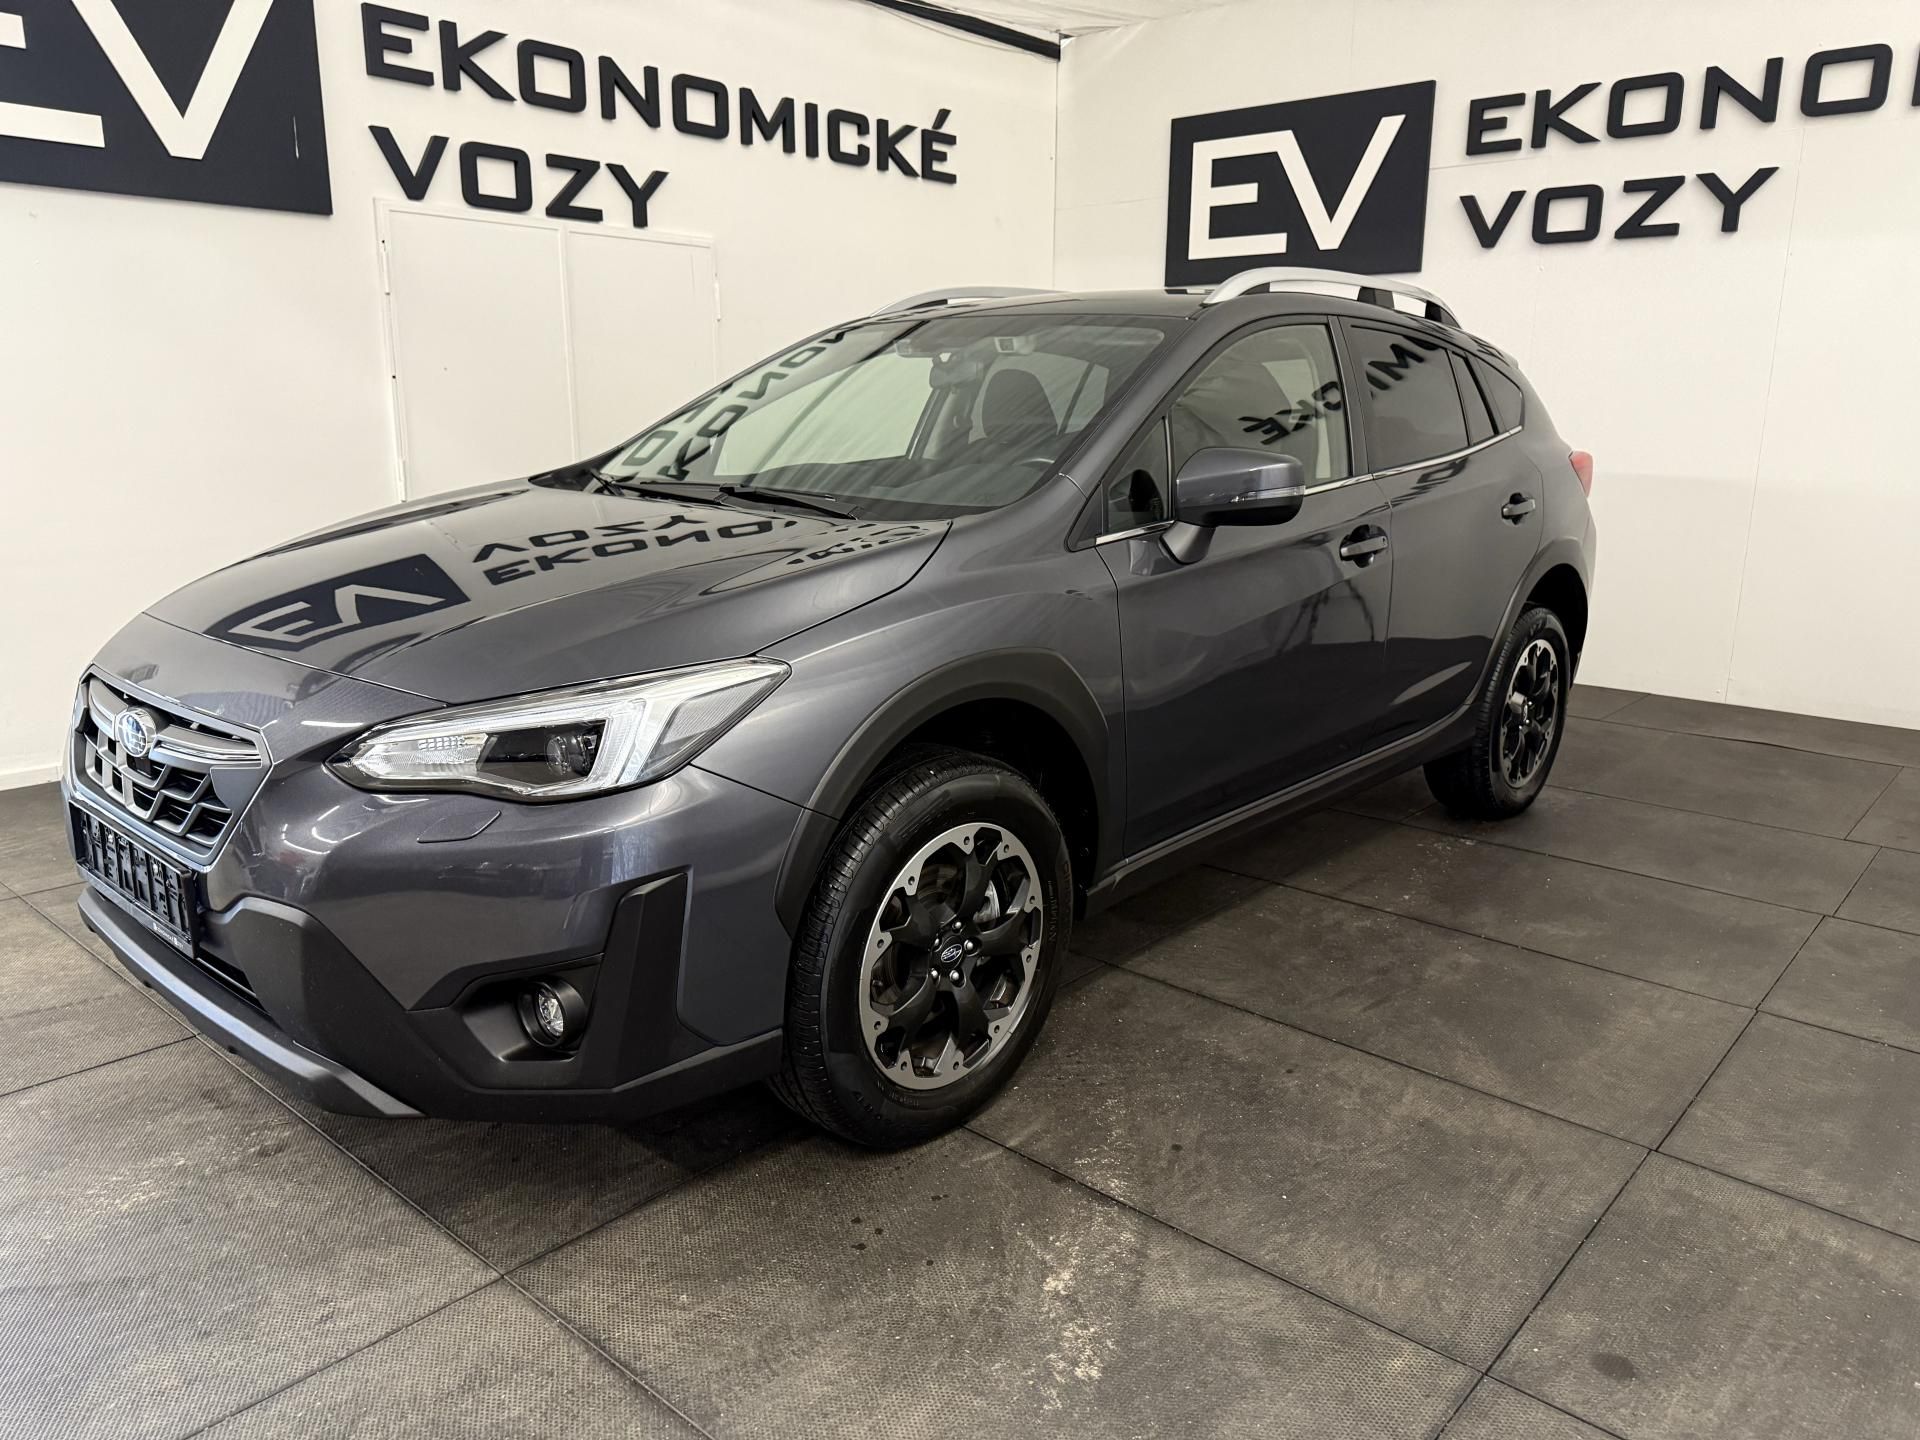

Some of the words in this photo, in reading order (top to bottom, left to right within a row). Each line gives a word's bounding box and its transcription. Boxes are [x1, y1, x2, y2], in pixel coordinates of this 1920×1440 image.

[361, 2, 957, 184] EKONOMICKÉ
[1467, 40, 1920, 156] EKONO
[368, 125, 669, 228] VOZY
[1188, 114, 1406, 260] EV
[1459, 167, 1780, 249] VOZY
